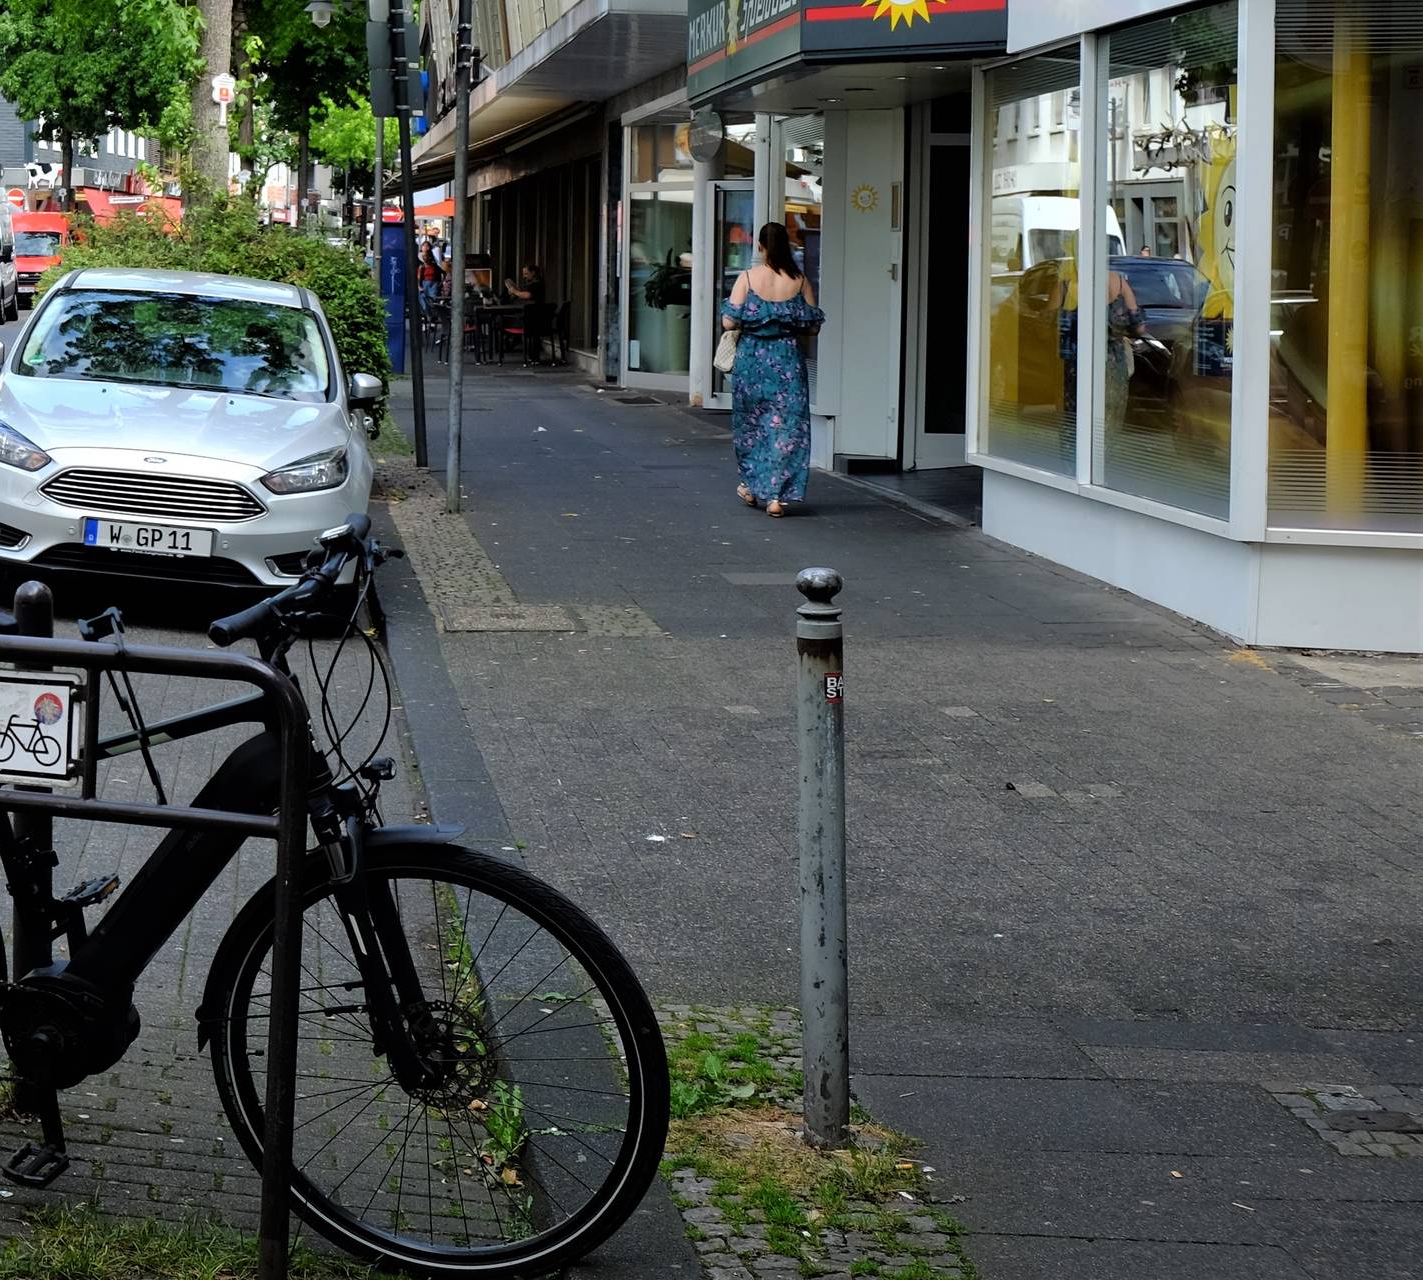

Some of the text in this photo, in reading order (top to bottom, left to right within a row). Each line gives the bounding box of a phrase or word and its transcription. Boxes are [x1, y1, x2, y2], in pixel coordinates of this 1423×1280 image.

[688, 1, 725, 60] MERKUR
[110, 525, 122, 544] W
[137, 528, 163, 547] GP
[168, 531, 192, 550] 11
